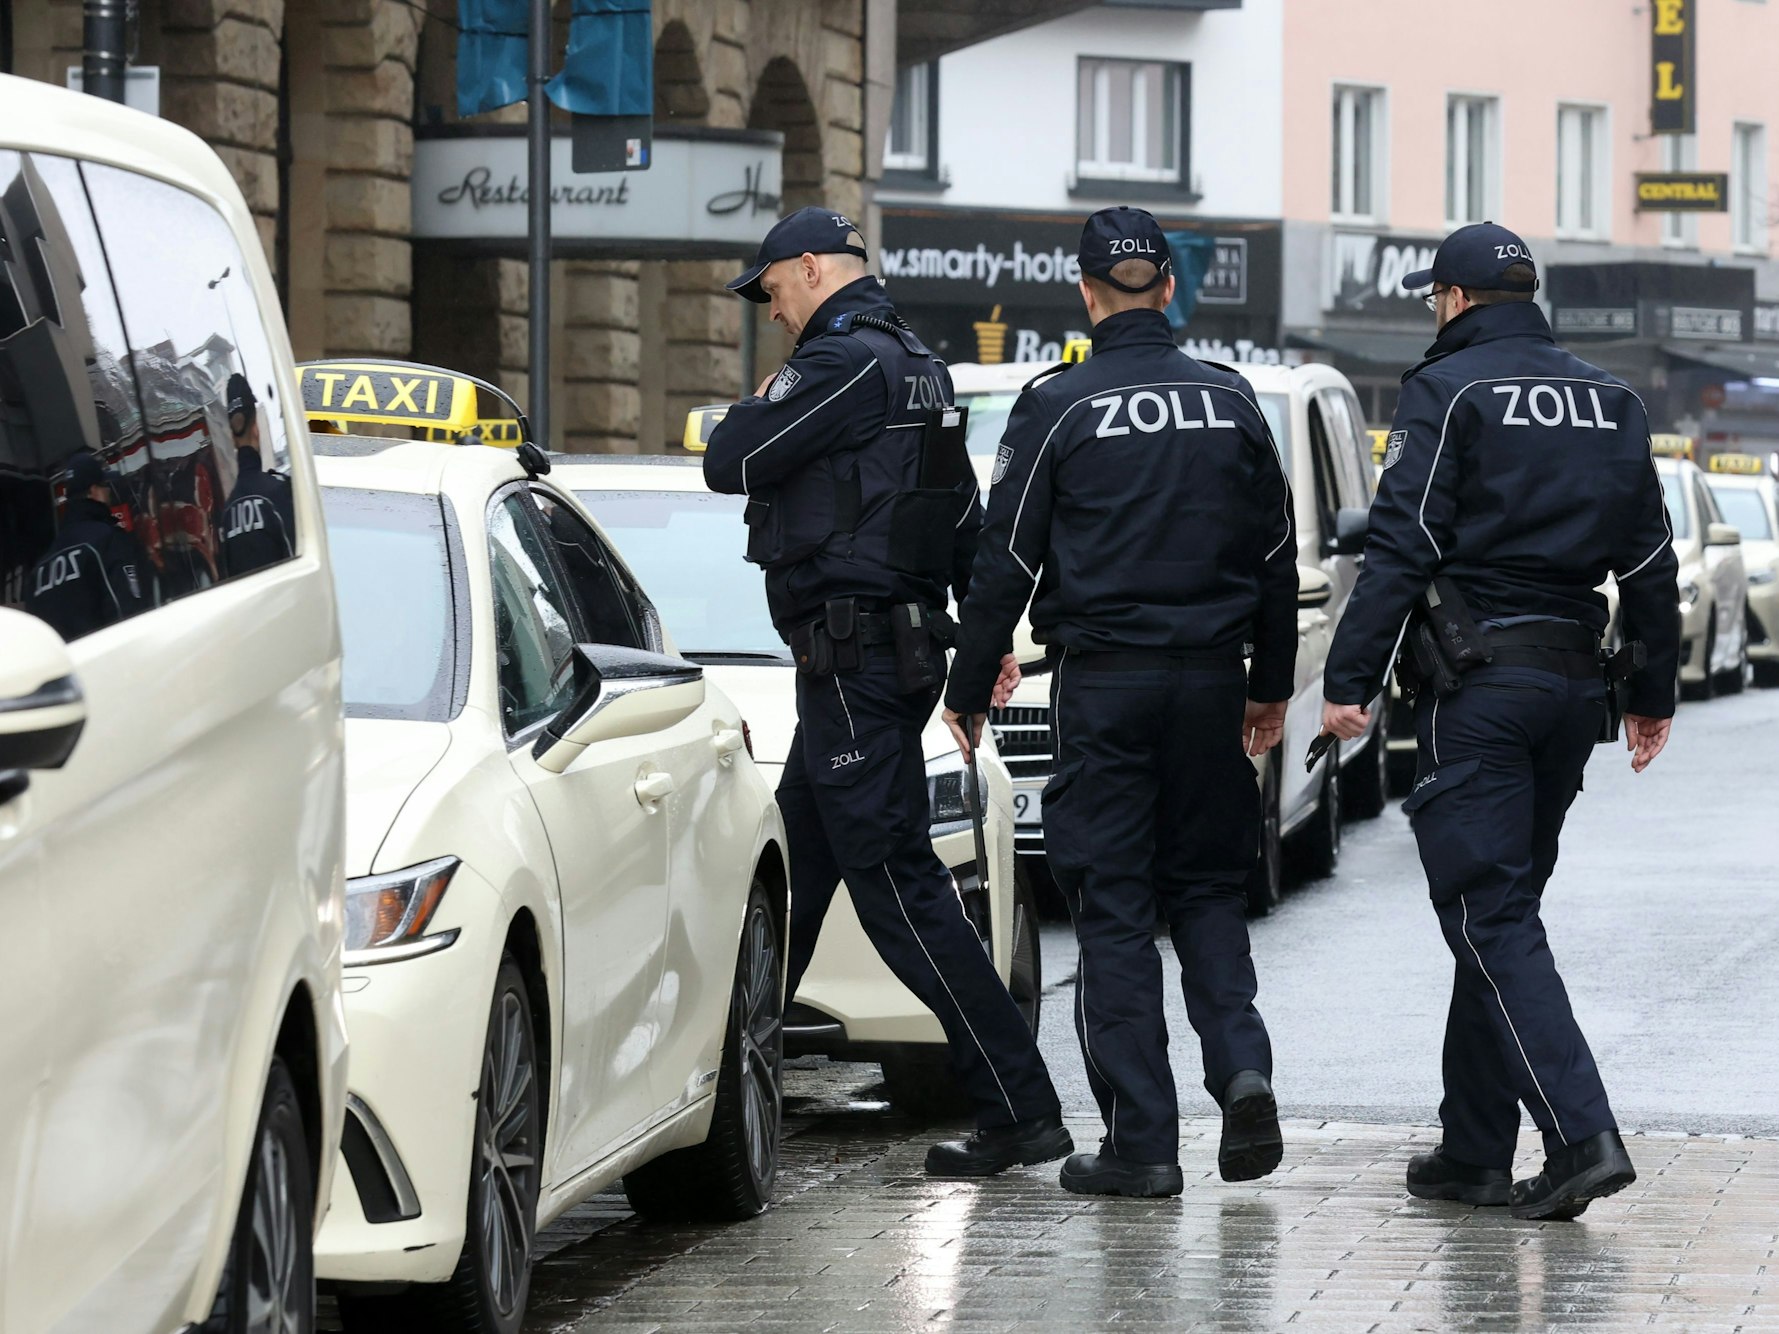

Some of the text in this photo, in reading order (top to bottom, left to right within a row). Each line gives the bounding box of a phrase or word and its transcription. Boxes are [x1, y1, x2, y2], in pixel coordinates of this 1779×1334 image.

[1638, 182, 1720, 201] CENTRAL
[1109, 238, 1157, 255] ZOLL
[1494, 244, 1533, 262] ZOLL
[1235, 340, 1279, 365] Tea
[315, 372, 438, 414] TAXI
[904, 375, 949, 410] ZOLL
[1090, 390, 1235, 438] ZOLL
[1492, 385, 1618, 430] ZOLL
[831, 750, 866, 769] ZOLL
[1013, 794, 1029, 818] 9
